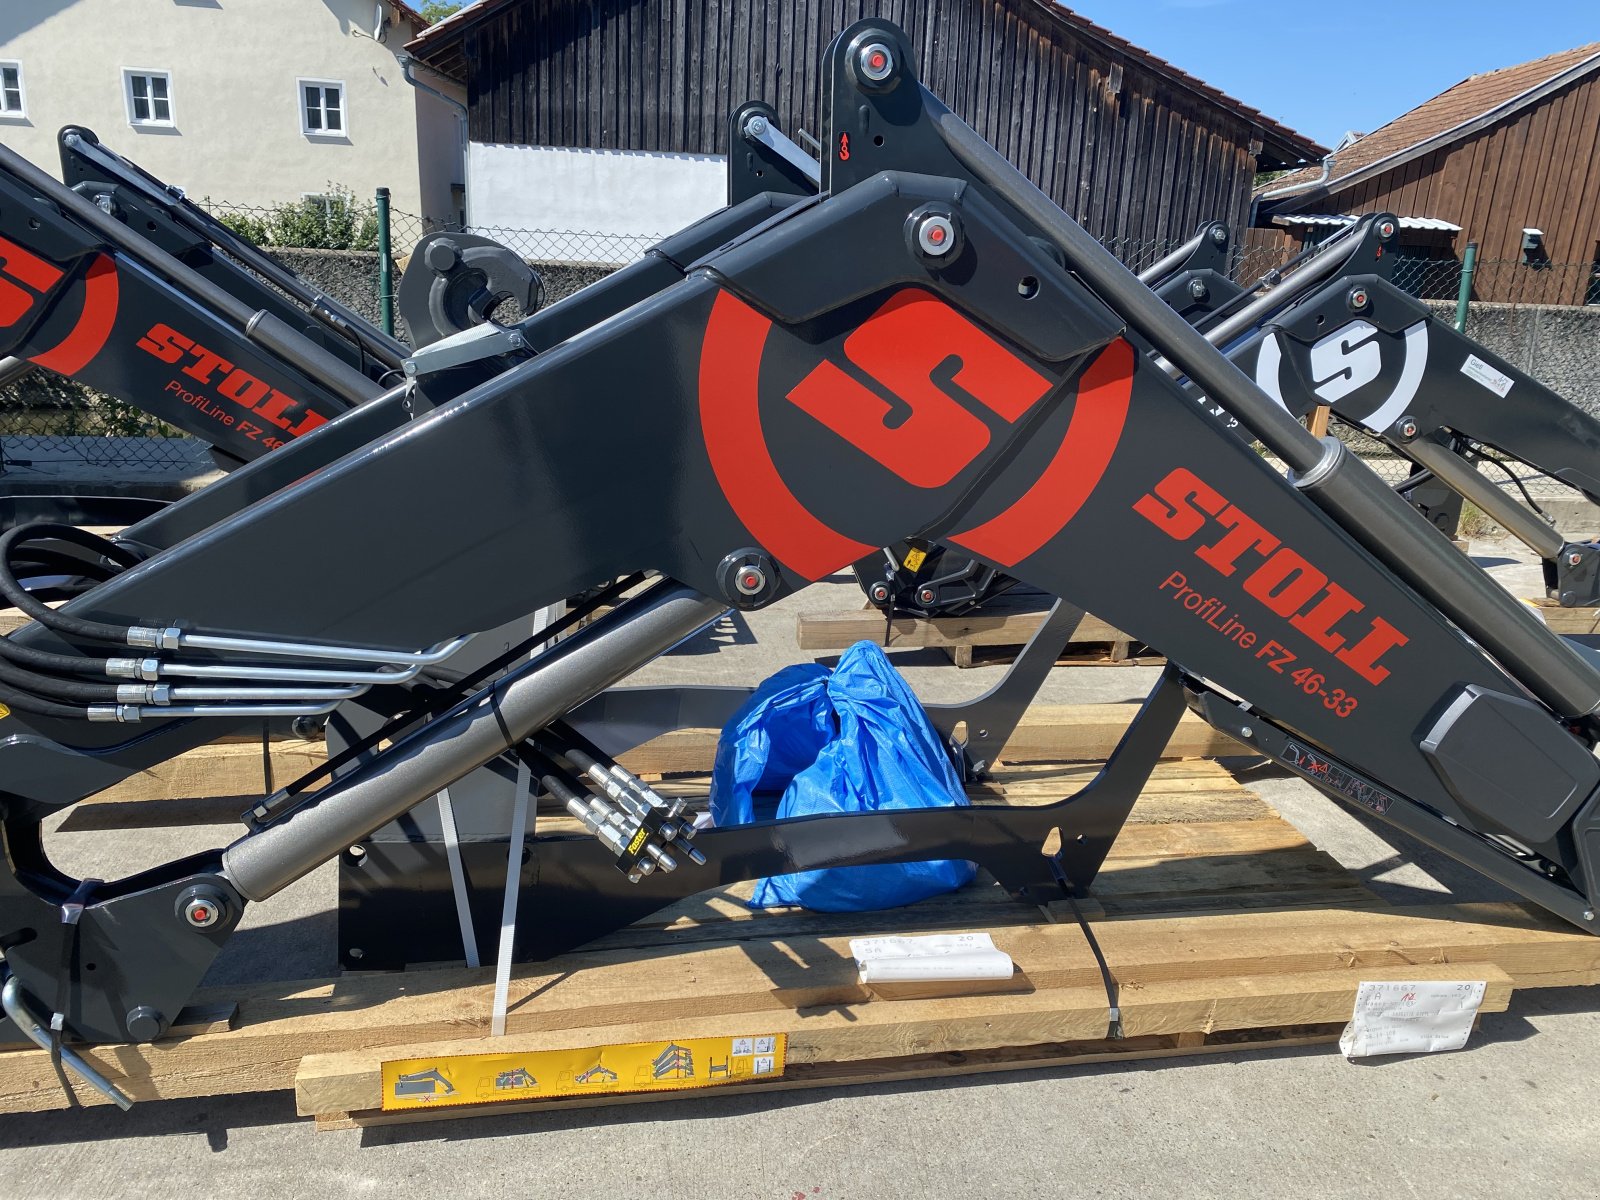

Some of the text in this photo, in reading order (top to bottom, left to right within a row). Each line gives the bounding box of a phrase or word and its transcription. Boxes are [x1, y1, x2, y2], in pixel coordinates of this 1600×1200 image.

[164, 380, 235, 426] ProfiLine
[235, 420, 264, 441] FZ
[1131, 467, 1410, 687] STOLL
[1158, 570, 1359, 718] ProfiLine FZ 46-33
[627, 827, 647, 855] Faster
